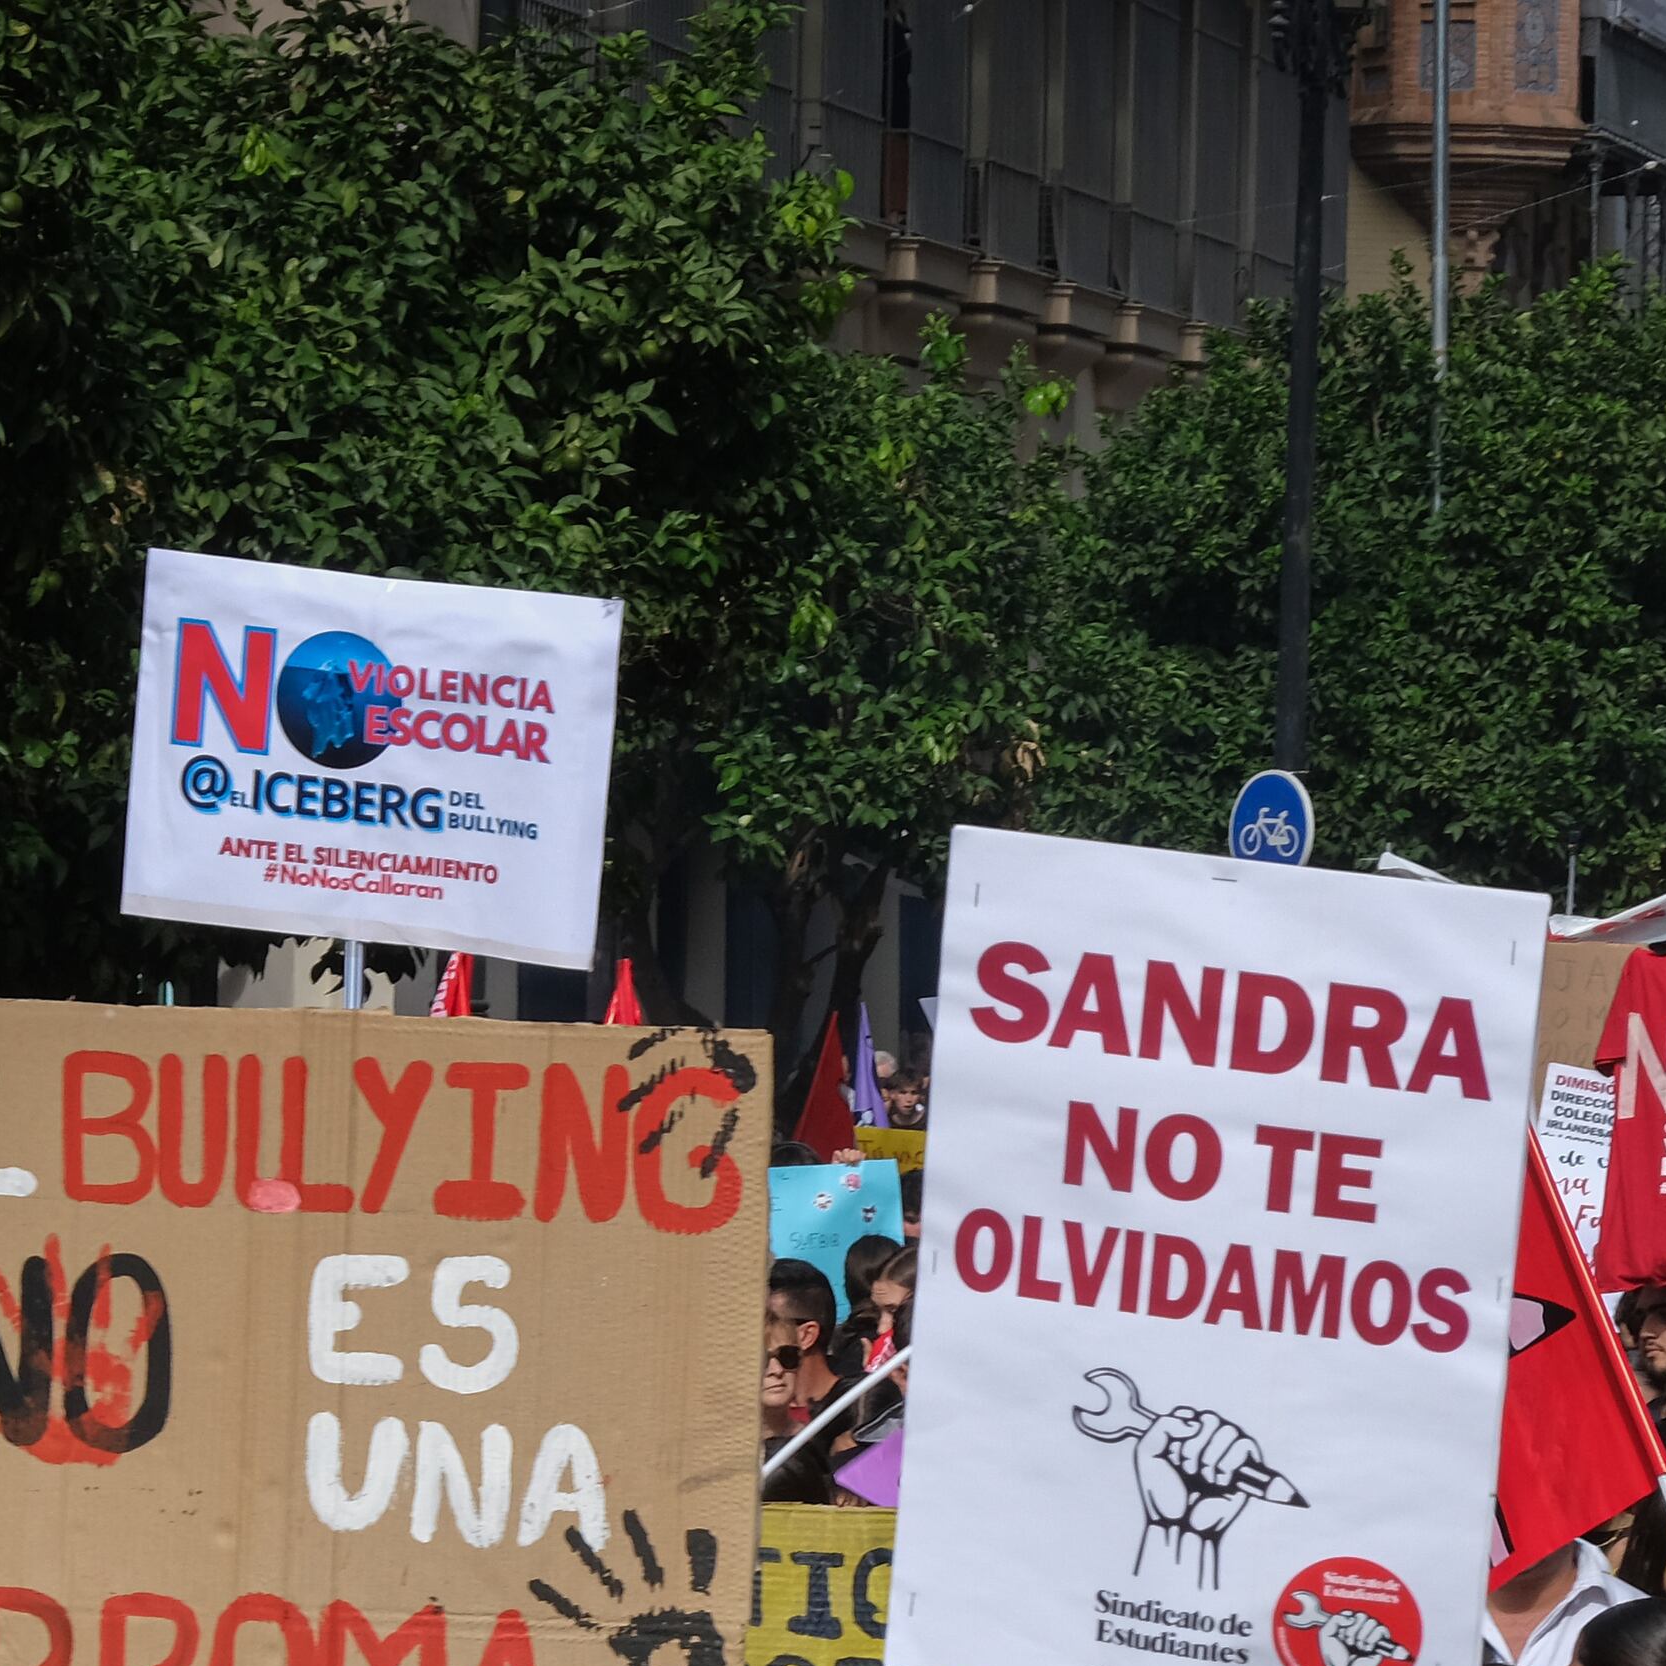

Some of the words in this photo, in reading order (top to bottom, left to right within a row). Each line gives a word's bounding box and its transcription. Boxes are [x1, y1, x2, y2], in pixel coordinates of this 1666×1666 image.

[348, 659, 555, 714] VIOLENCIA
[363, 705, 551, 764] ESCOLAR
[447, 812, 538, 840] BULLYING
[448, 790, 485, 811] DEL
[218, 836, 277, 862] ANTE
[284, 842, 307, 865] EL
[313, 846, 499, 885] SILENCIAMIENTO
[263, 863, 443, 901] #NoNosCallaran
[970, 940, 1491, 1102] SANDRA
[61, 1049, 744, 1236] BULLYING
[1062, 1100, 1223, 1203] NO
[1255, 1122, 1384, 1224] TE
[954, 1207, 1472, 1354] OLVIDAMOS
[307, 1253, 520, 1395] ES
[305, 1410, 613, 1550] UNA
[1095, 1588, 1215, 1634] Sindicato
[1218, 1612, 1253, 1638] de
[1095, 1620, 1250, 1666] Estudiantes
